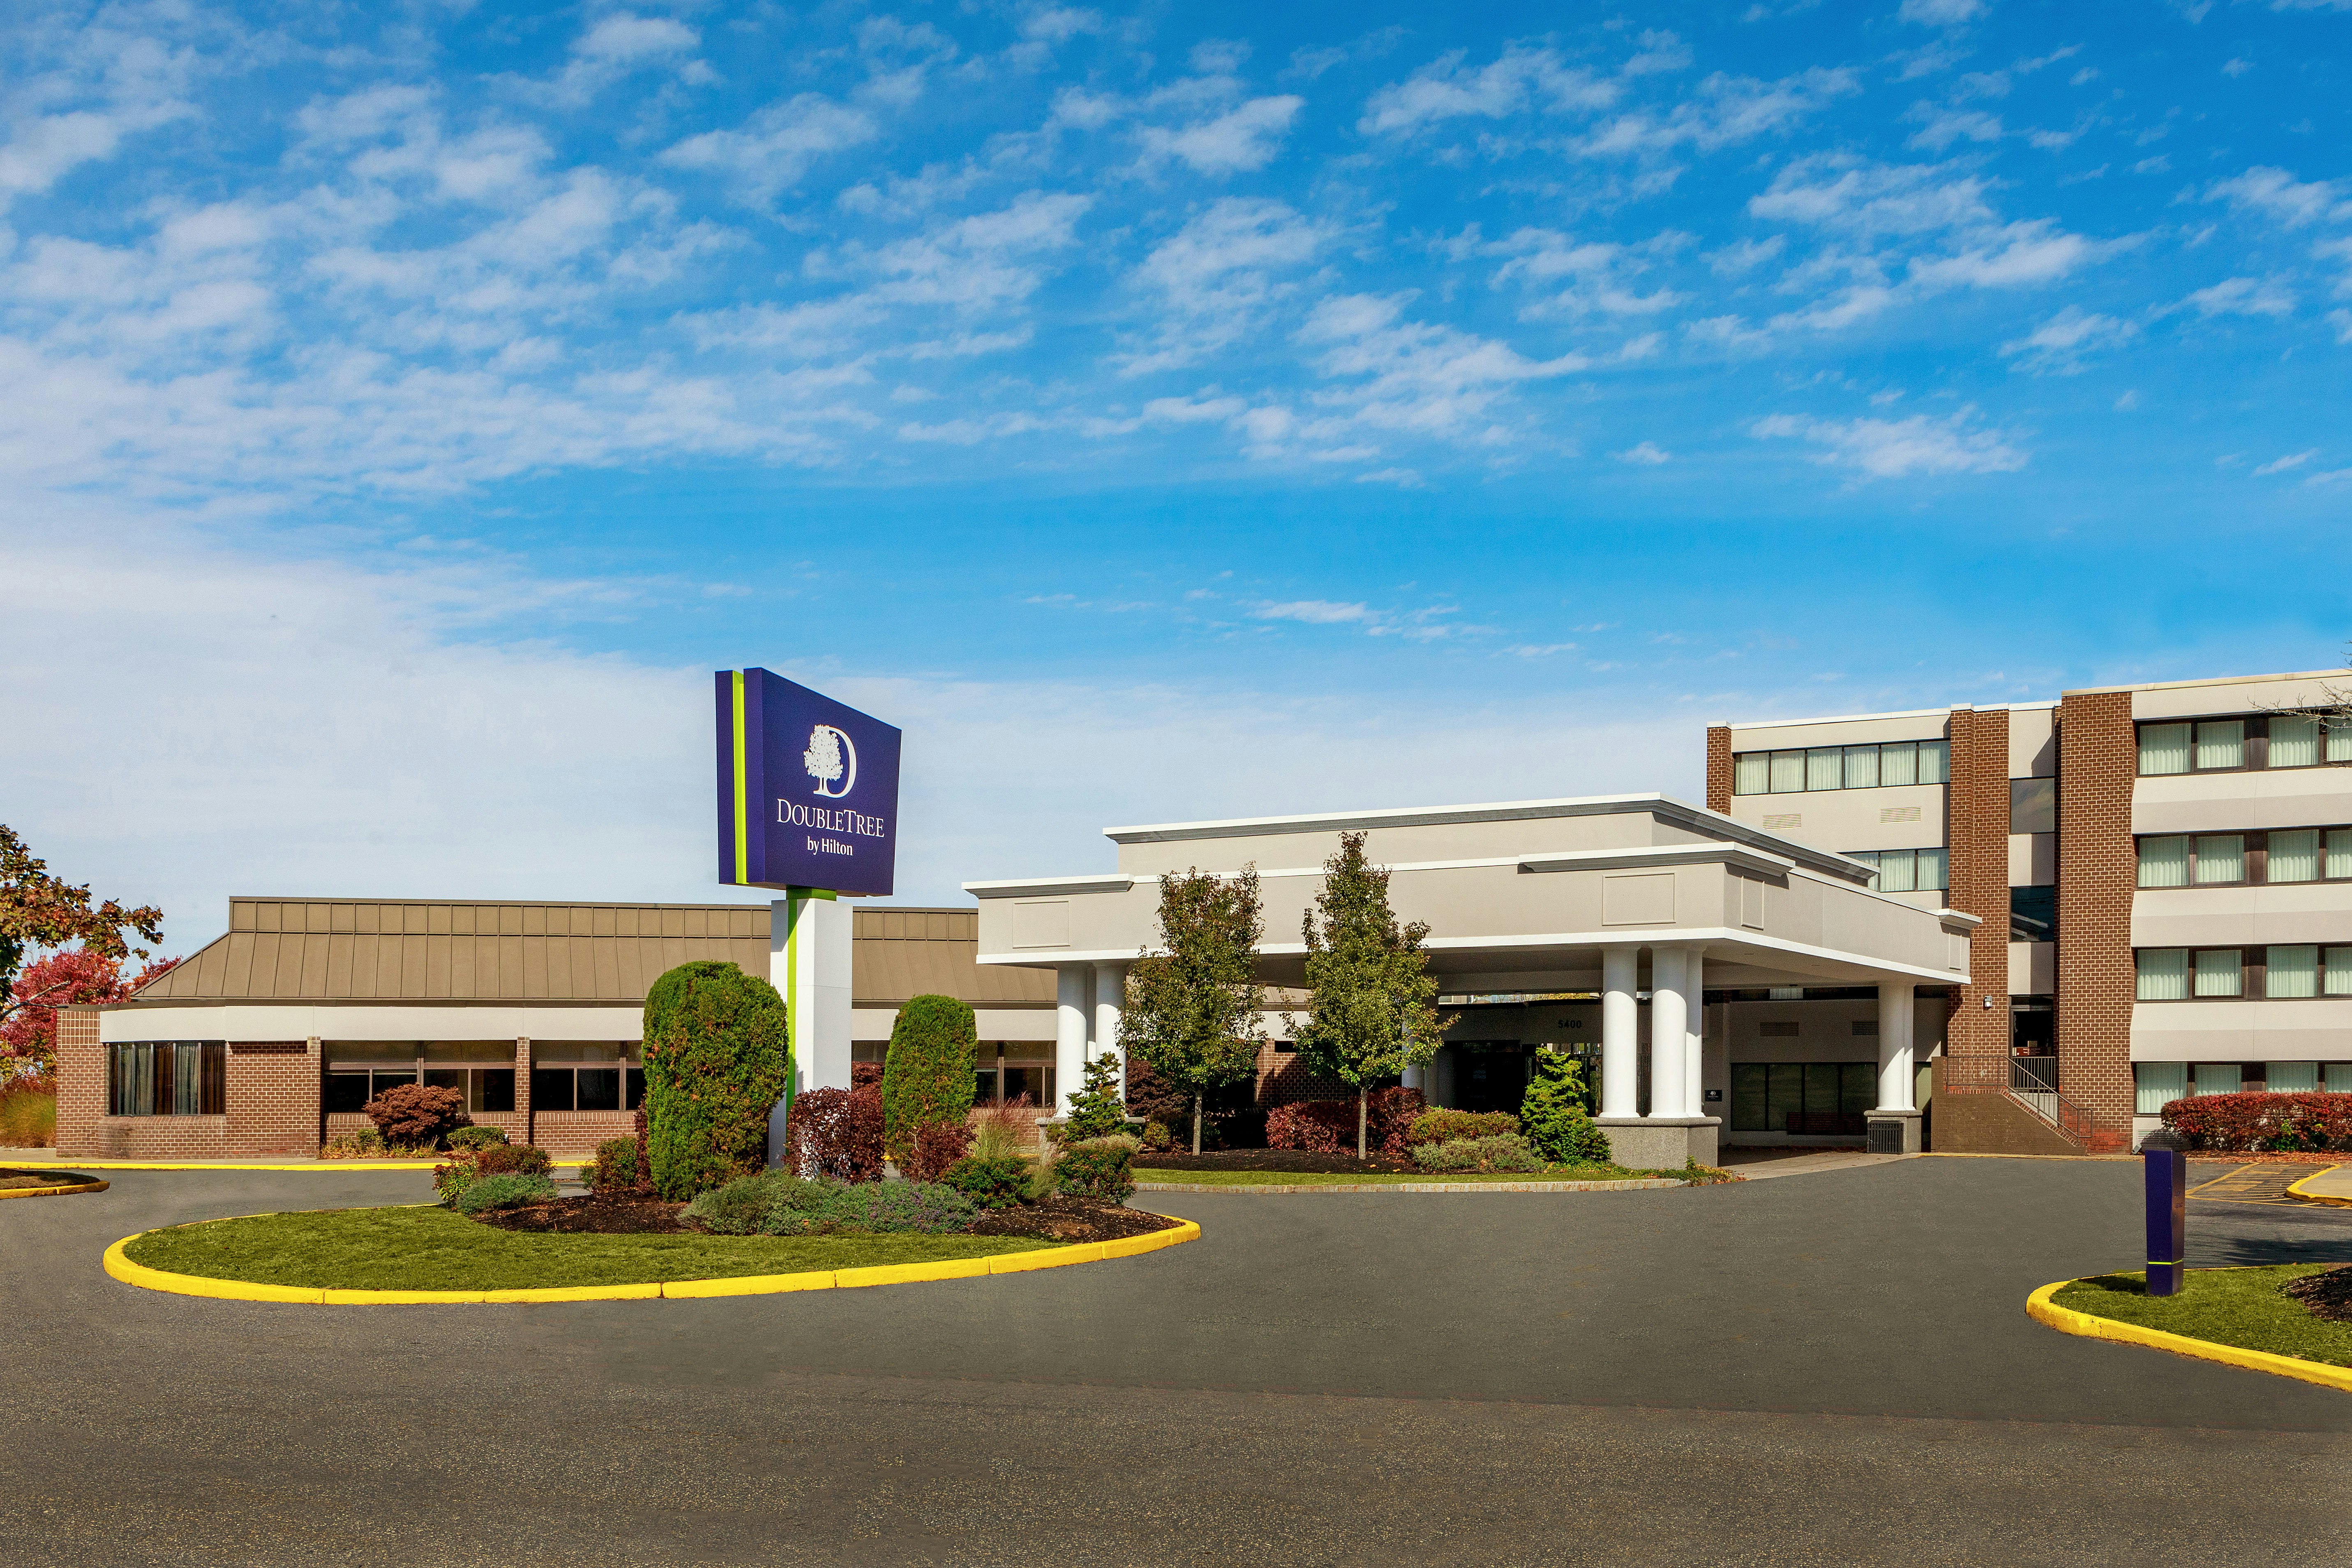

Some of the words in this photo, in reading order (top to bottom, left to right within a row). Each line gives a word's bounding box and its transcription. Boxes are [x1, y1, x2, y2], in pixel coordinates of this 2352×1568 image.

[807, 836, 819, 855] by
[822, 838, 853, 856] Hilton
[1558, 1020, 1582, 1028] 5400
